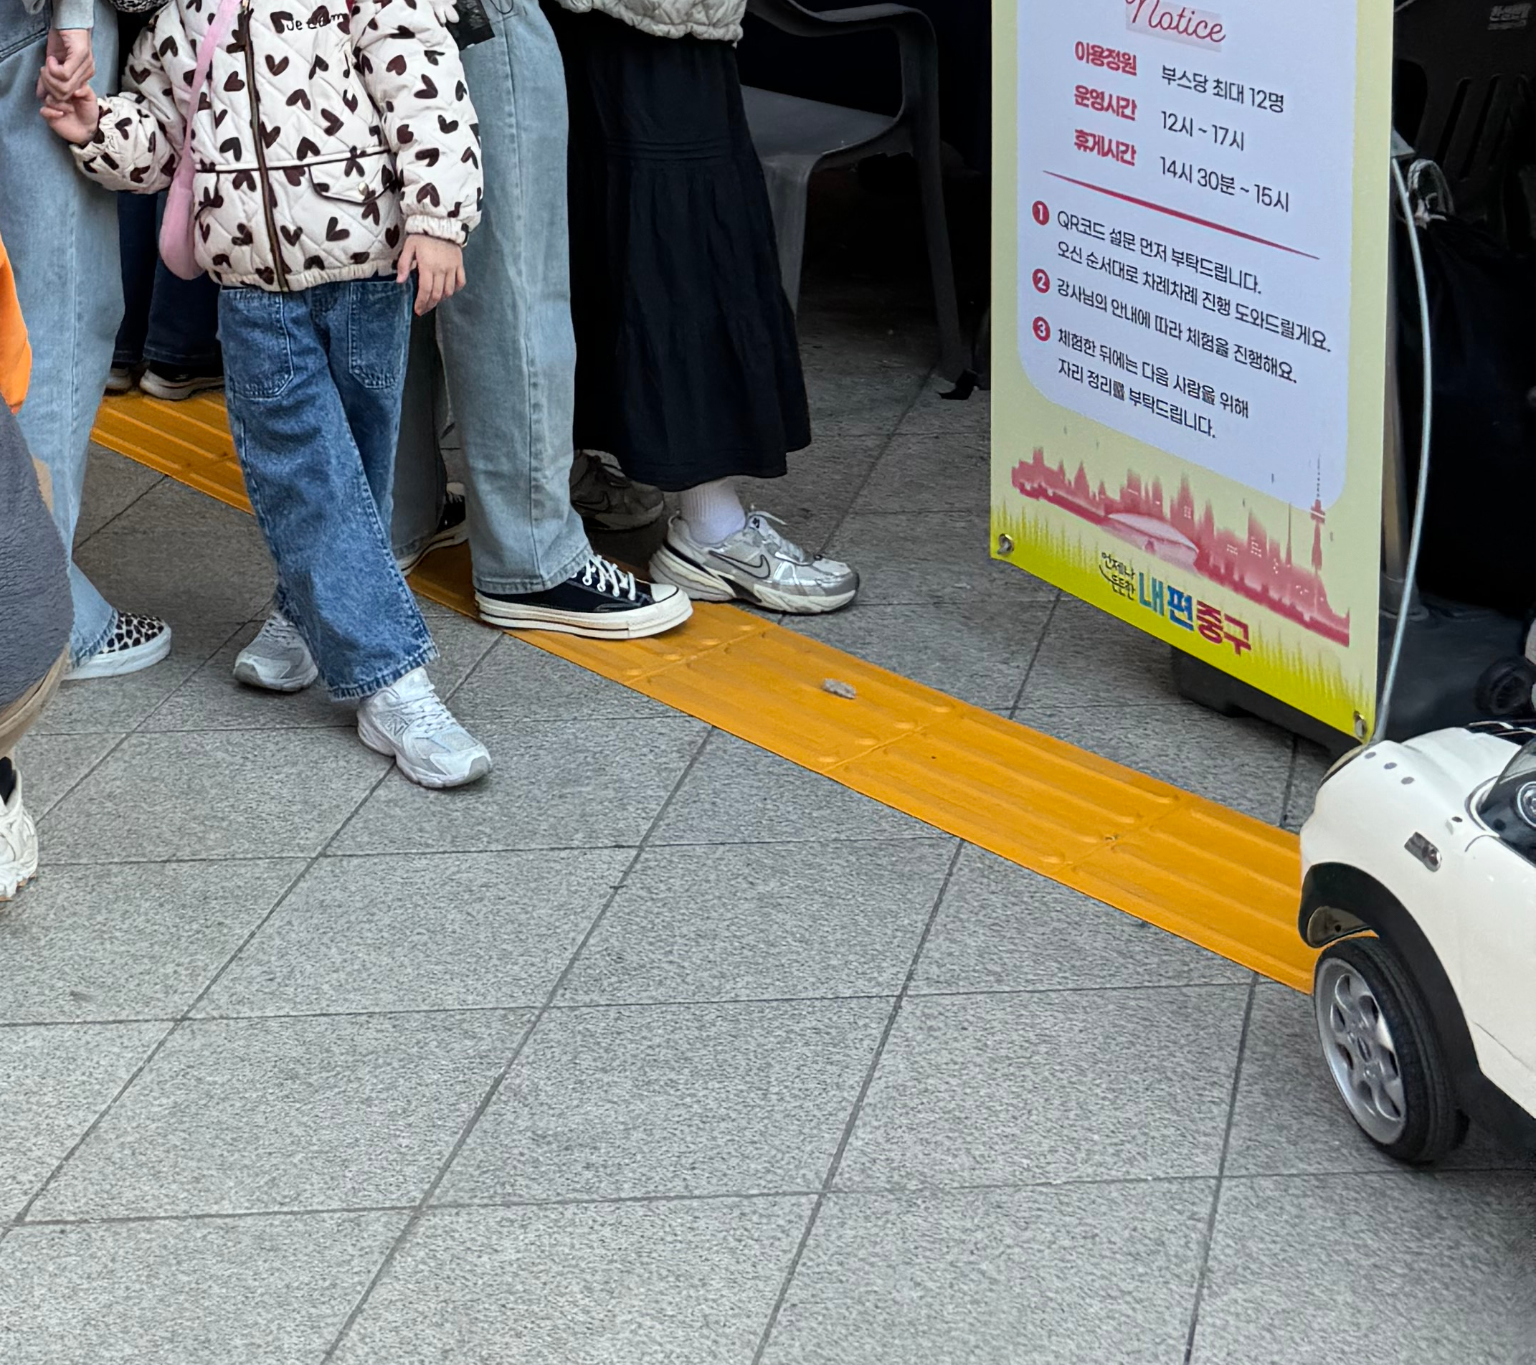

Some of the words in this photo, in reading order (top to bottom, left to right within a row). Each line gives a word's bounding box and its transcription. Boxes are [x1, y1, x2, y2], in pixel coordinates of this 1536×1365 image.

[1074, 40, 1138, 77] 이용정원
[1073, 84, 1138, 122] 운영시간
[1161, 64, 1210, 96] 부스당
[1212, 76, 1246, 105] 최대
[1248, 86, 1285, 114] 12명
[1073, 128, 1137, 167] 휴게시간
[1161, 110, 1194, 138] 12시
[1212, 123, 1245, 151] 17시
[1159, 155, 1194, 183] 14시
[1197, 167, 1237, 197] 30분
[1252, 184, 1290, 213] 15시
[1057, 210, 1106, 241] QR코드
[1109, 226, 1137, 250] 설문
[1139, 236, 1168, 262] 먼저
[1171, 247, 1263, 295] 부탁드립니다.
[1057, 240, 1083, 265] 오신
[1085, 250, 1140, 284] 순서대로
[1142, 271, 1199, 305] 차례차례
[1201, 291, 1231, 317] 진행
[1234, 302, 1332, 353] 도와드릴게요.
[1056, 278, 1109, 314] 강사님의
[1111, 296, 1152, 330] 안내에
[1154, 314, 1183, 341] 따라
[1186, 326, 1230, 359] 체험을
[1233, 343, 1298, 385] 진행해요.
[1057, 327, 1097, 359] 체험한
[1099, 344, 1139, 375] 뒤에는
[1141, 361, 1170, 388] 다음
[1173, 374, 1216, 406] 사람을
[1219, 391, 1250, 419] 위해
[1057, 358, 1083, 384] 자리
[1086, 369, 1126, 402] 정리를
[1128, 387, 1216, 439] 부탁드립니다.
